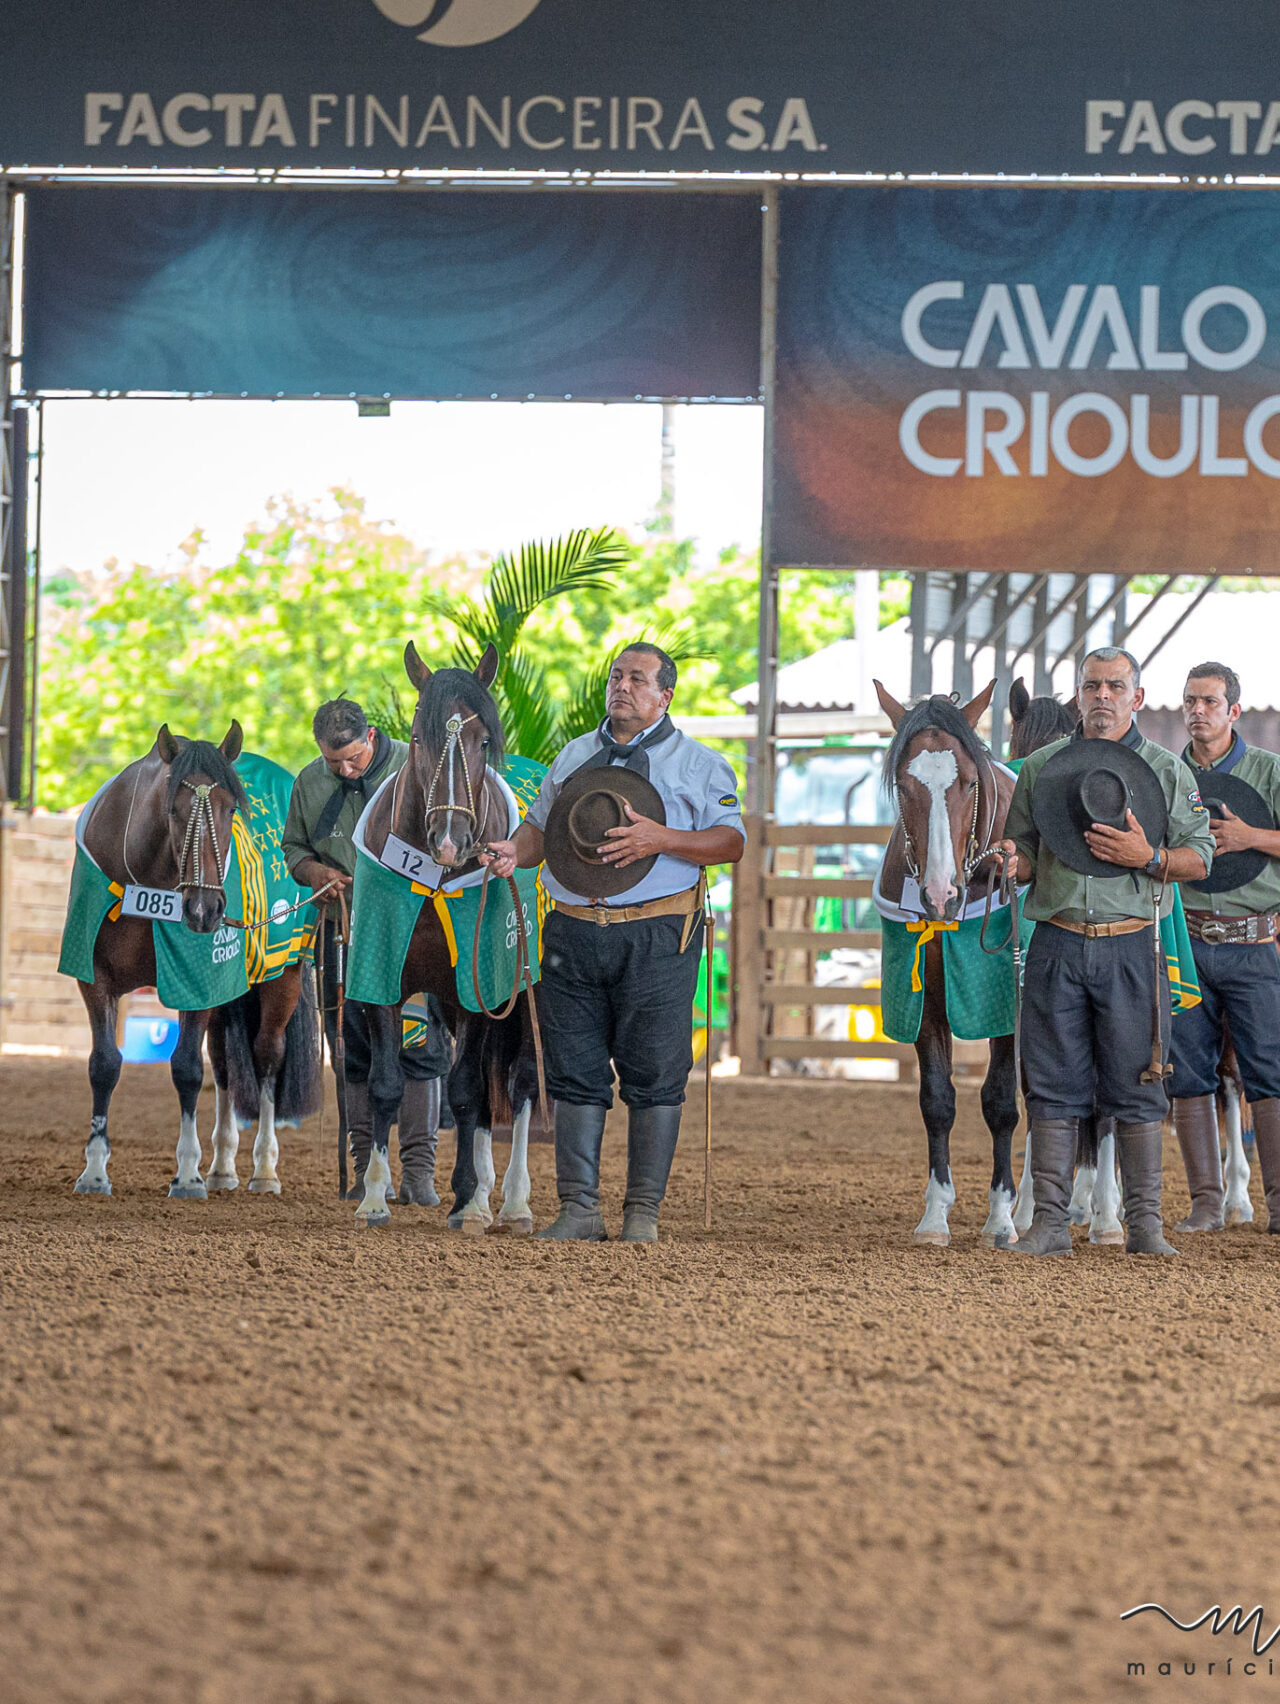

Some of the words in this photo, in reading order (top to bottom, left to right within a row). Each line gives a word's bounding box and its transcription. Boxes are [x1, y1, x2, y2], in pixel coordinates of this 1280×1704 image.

[84, 92, 297, 148] FACTA
[309, 94, 717, 152] FINANCEIRA
[726, 97, 829, 153] S.A.
[901, 280, 1268, 373] CAVALO
[401, 849, 424, 877] 12
[135, 890, 175, 917] 085
